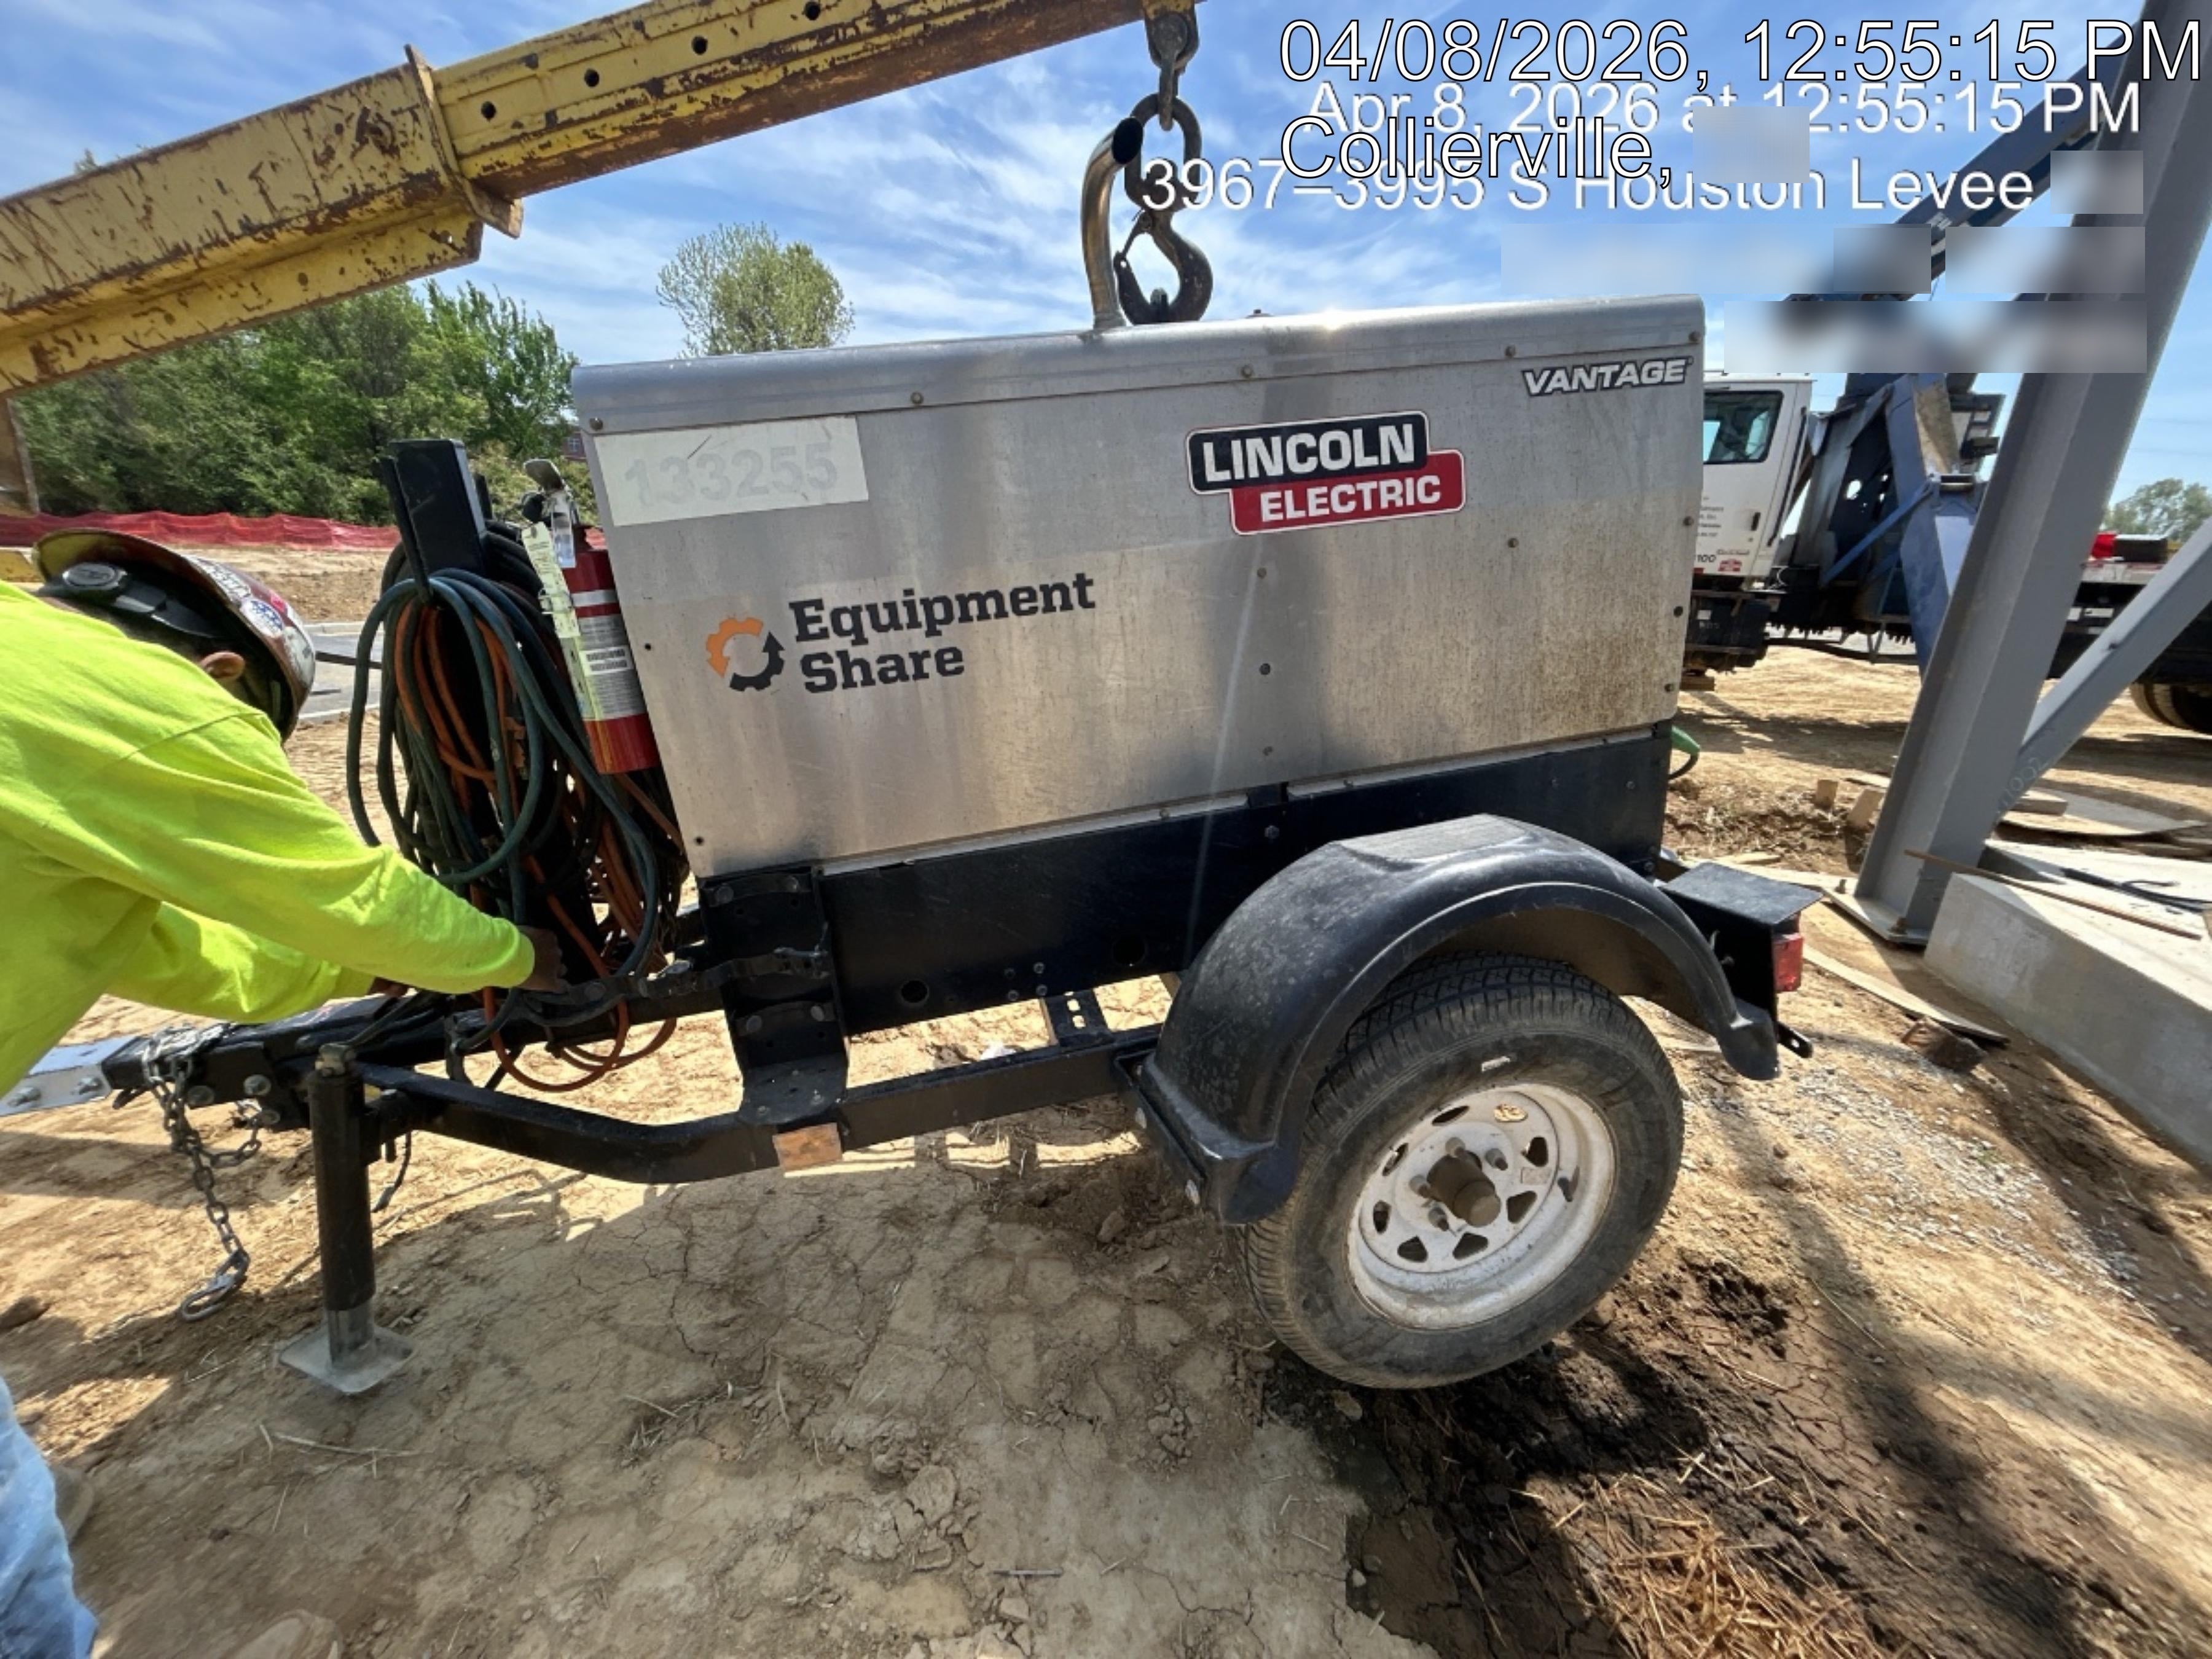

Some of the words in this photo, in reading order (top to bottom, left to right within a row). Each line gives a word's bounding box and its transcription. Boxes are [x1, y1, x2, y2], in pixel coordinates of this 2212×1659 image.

[1523, 358, 1687, 396] VANTAGE
[624, 441, 838, 506] 133255
[1202, 423, 1414, 482] LINCOLN
[1260, 475, 1441, 522] ELECTRIC
[788, 573, 1096, 646] Equipment
[800, 646, 965, 693] Share
